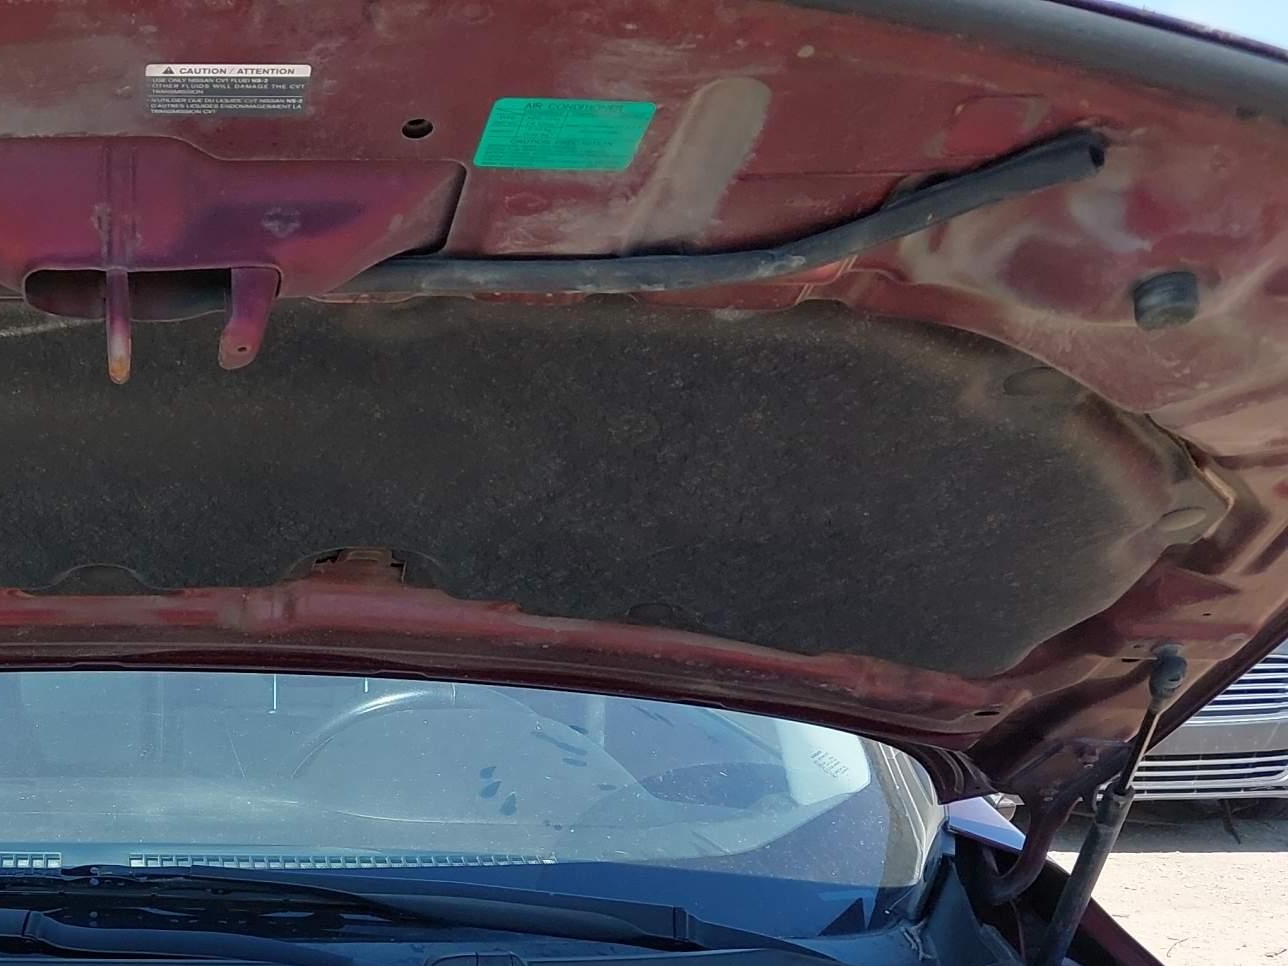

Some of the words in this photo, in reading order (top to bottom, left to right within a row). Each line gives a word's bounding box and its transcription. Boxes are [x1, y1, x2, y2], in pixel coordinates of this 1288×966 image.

[179, 67, 227, 75] CAUTION
[237, 67, 296, 75] ATTENTION
[525, 102, 543, 111] AIR
[548, 103, 624, 113] CONDITIONER
